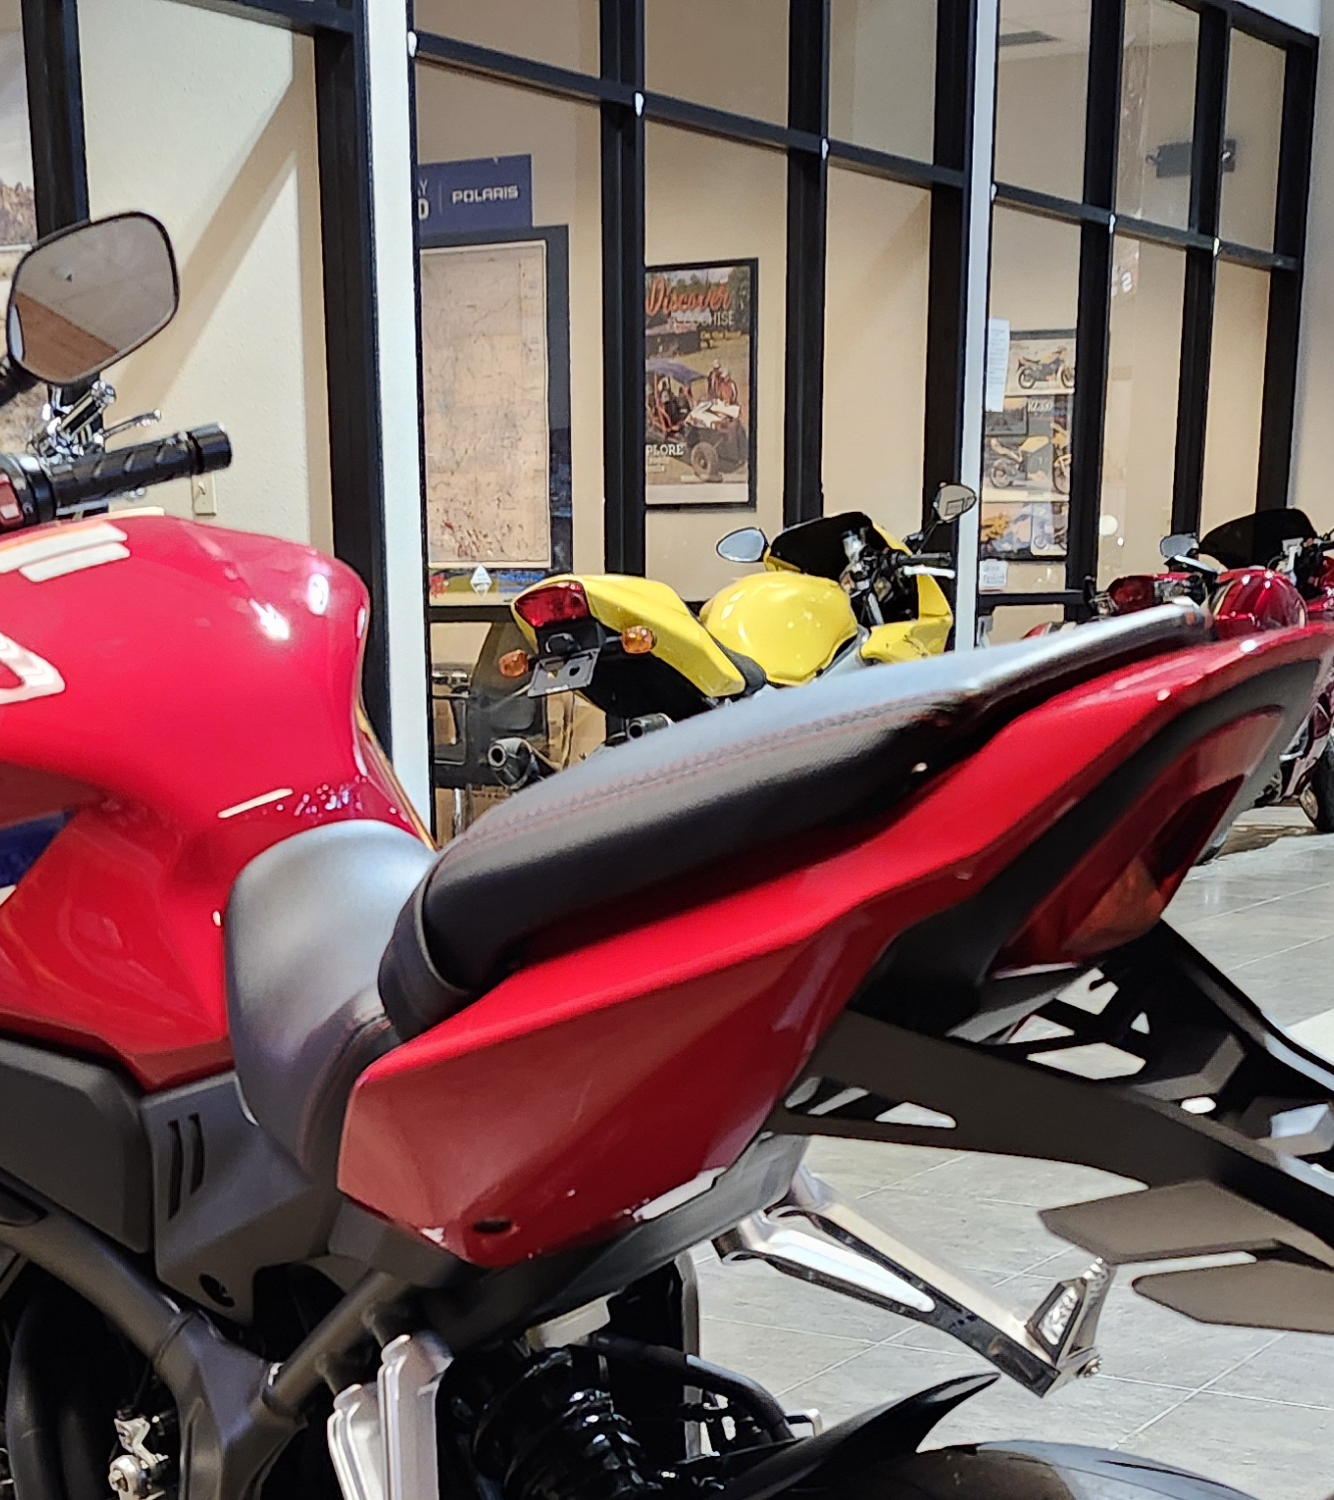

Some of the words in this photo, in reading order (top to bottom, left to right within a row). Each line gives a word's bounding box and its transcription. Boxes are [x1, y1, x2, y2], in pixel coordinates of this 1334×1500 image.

[451, 185, 520, 205] POLARIS
[646, 276, 731, 317] Discover
[645, 443, 685, 456] PLORE
